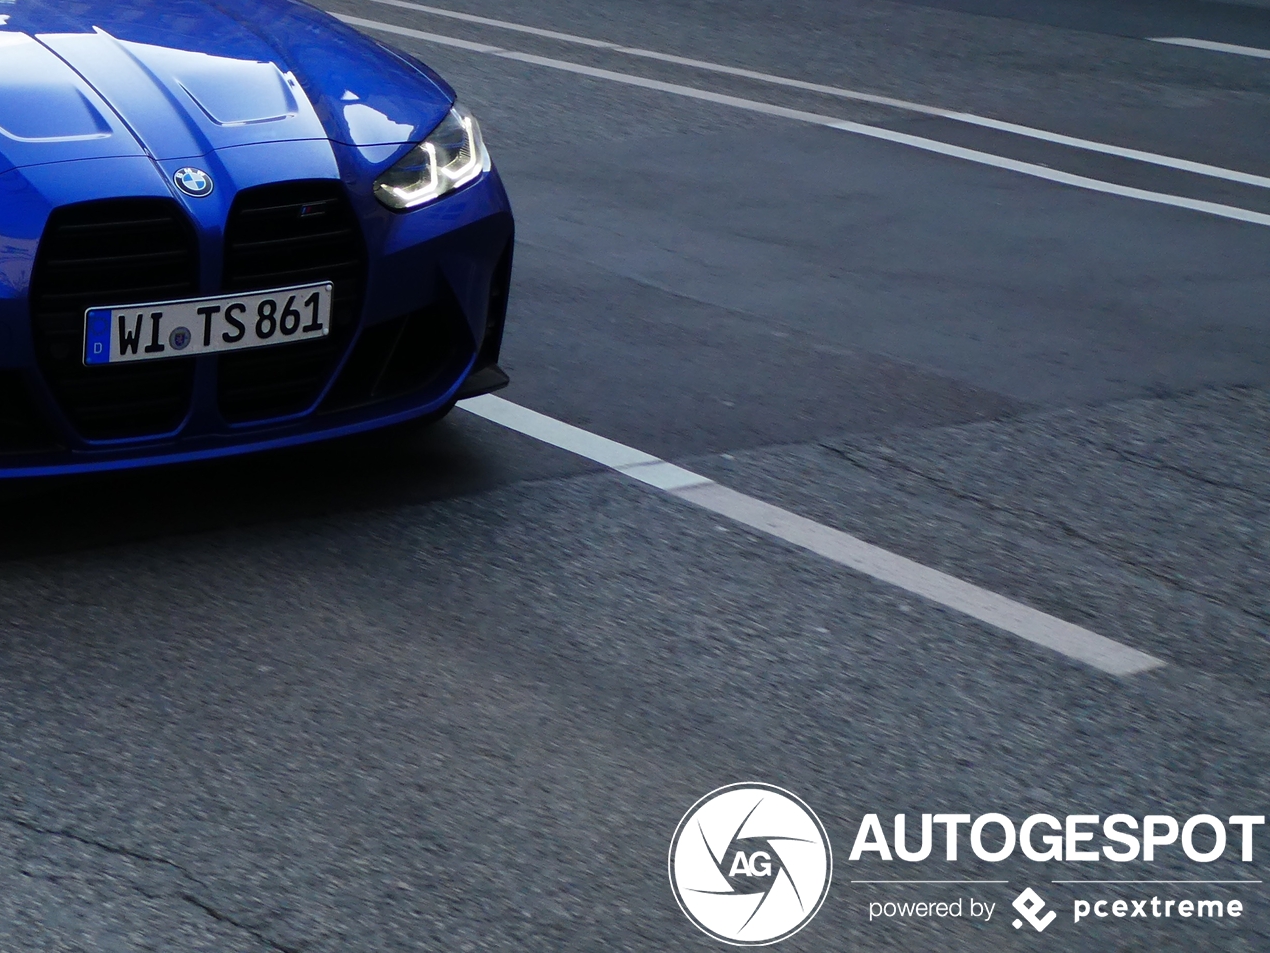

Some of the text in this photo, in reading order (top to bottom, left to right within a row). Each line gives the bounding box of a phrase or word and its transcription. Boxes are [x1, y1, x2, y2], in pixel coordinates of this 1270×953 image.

[118, 312, 165, 355] WI
[197, 303, 246, 346] TS
[255, 292, 323, 339] 861
